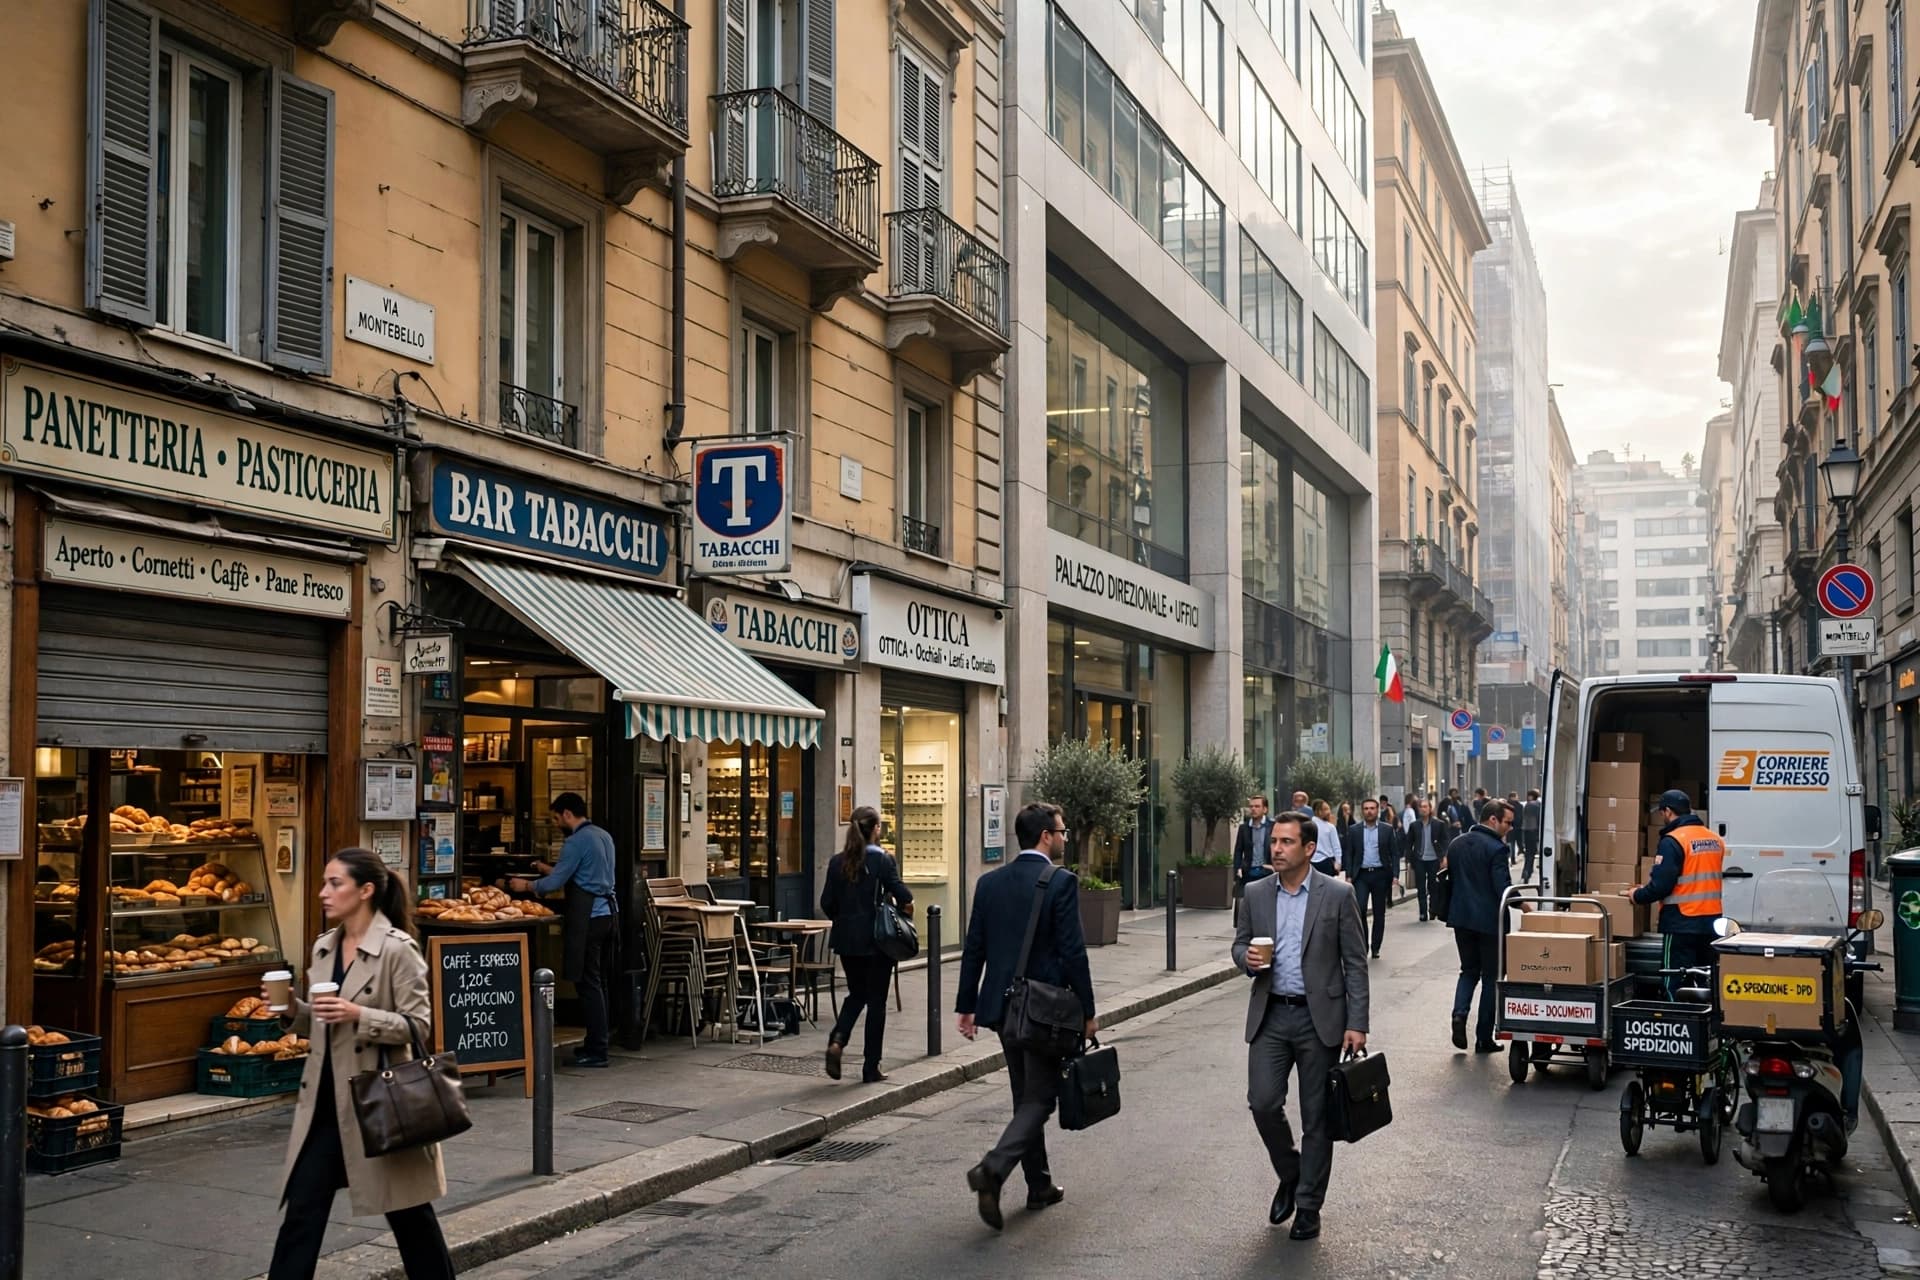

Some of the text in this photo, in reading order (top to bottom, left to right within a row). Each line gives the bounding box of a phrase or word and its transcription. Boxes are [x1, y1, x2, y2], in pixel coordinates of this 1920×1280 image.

[382, 297, 398, 317] VIA
[358, 312, 425, 348] MONTEBELLO
[22, 385, 382, 514] PANETTERIA PASTICCERIA
[712, 455, 766, 527] T
[449, 471, 659, 567] BAR TABACCHI
[699, 540, 780, 557] TABACCHI
[55, 535, 344, 601] Aperto Cornetti Caffè Pane Fresco
[1055, 554, 1199, 628] PALAZZO DIREZIONALE UFFICI
[734, 604, 838, 654] TABACCHI
[907, 601, 970, 647] OTTICA
[879, 636, 909, 658] OTTICA
[1757, 756, 1829, 770] CORRIERE
[1756, 771, 1830, 786] ESPRESSO
[480, 953, 520, 968] ESPRESSO
[459, 973, 493, 990] 1,20€
[449, 990, 515, 1008] CAPPUCCINO
[464, 1011, 496, 1029] 1,50€
[1507, 1002, 1593, 1019] FRAGILE DOCUMENTI
[1625, 1020, 1690, 1038] LOGISTICA
[457, 1031, 508, 1050] APERTO
[1623, 1037, 1693, 1055] SPEDIZIONI
